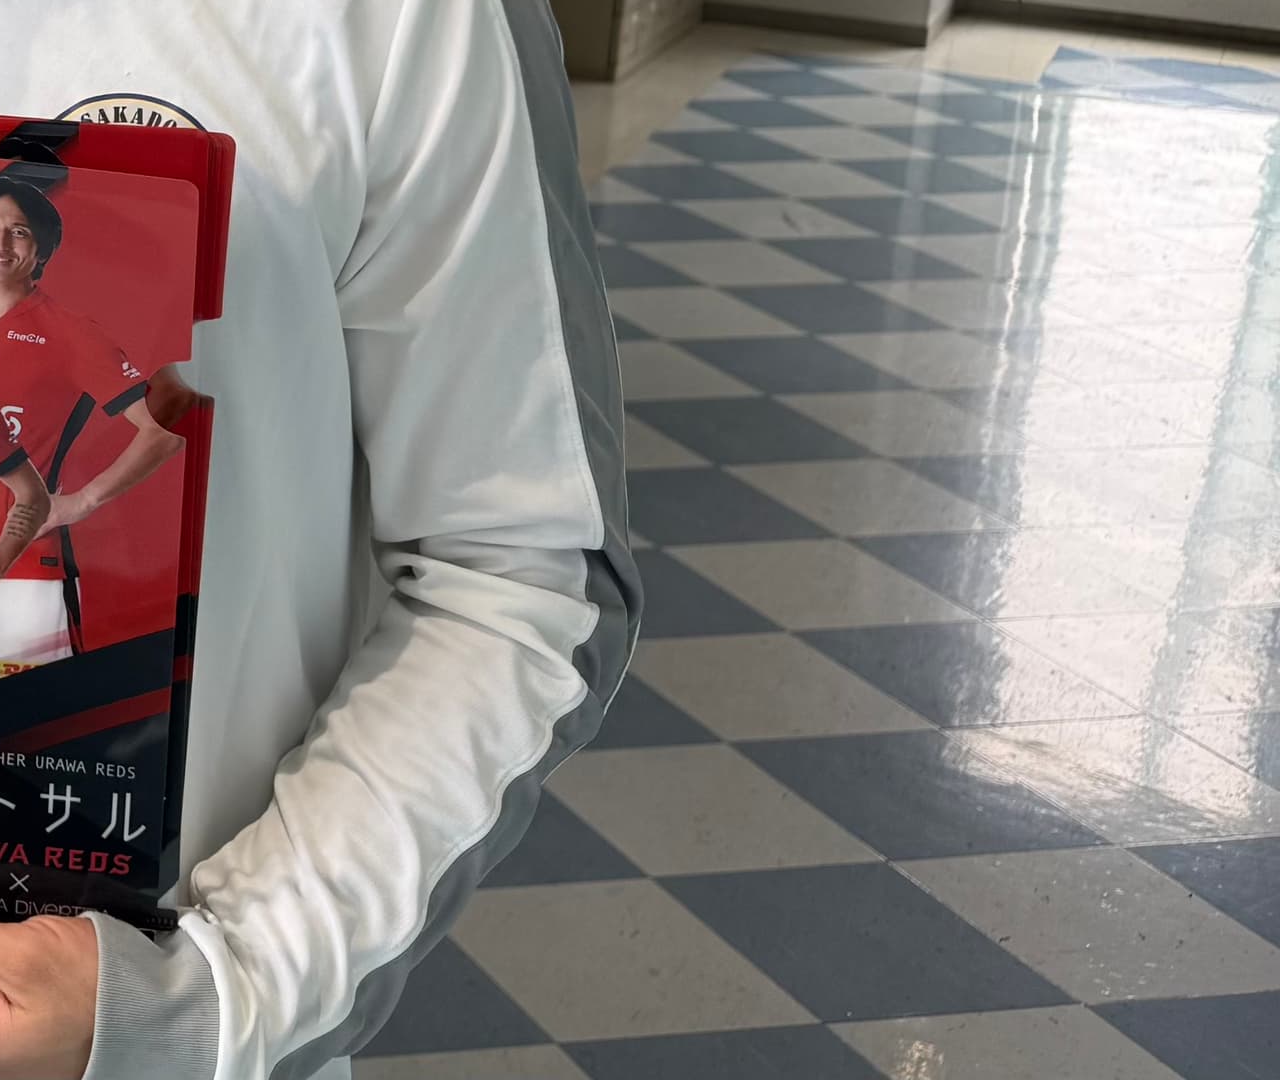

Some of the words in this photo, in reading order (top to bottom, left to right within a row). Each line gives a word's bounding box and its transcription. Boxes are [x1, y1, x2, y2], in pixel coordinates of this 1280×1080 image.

[34, 755, 87, 775] URAWA
[95, 763, 137, 780] REDS
[43, 846, 133, 876] REDS
